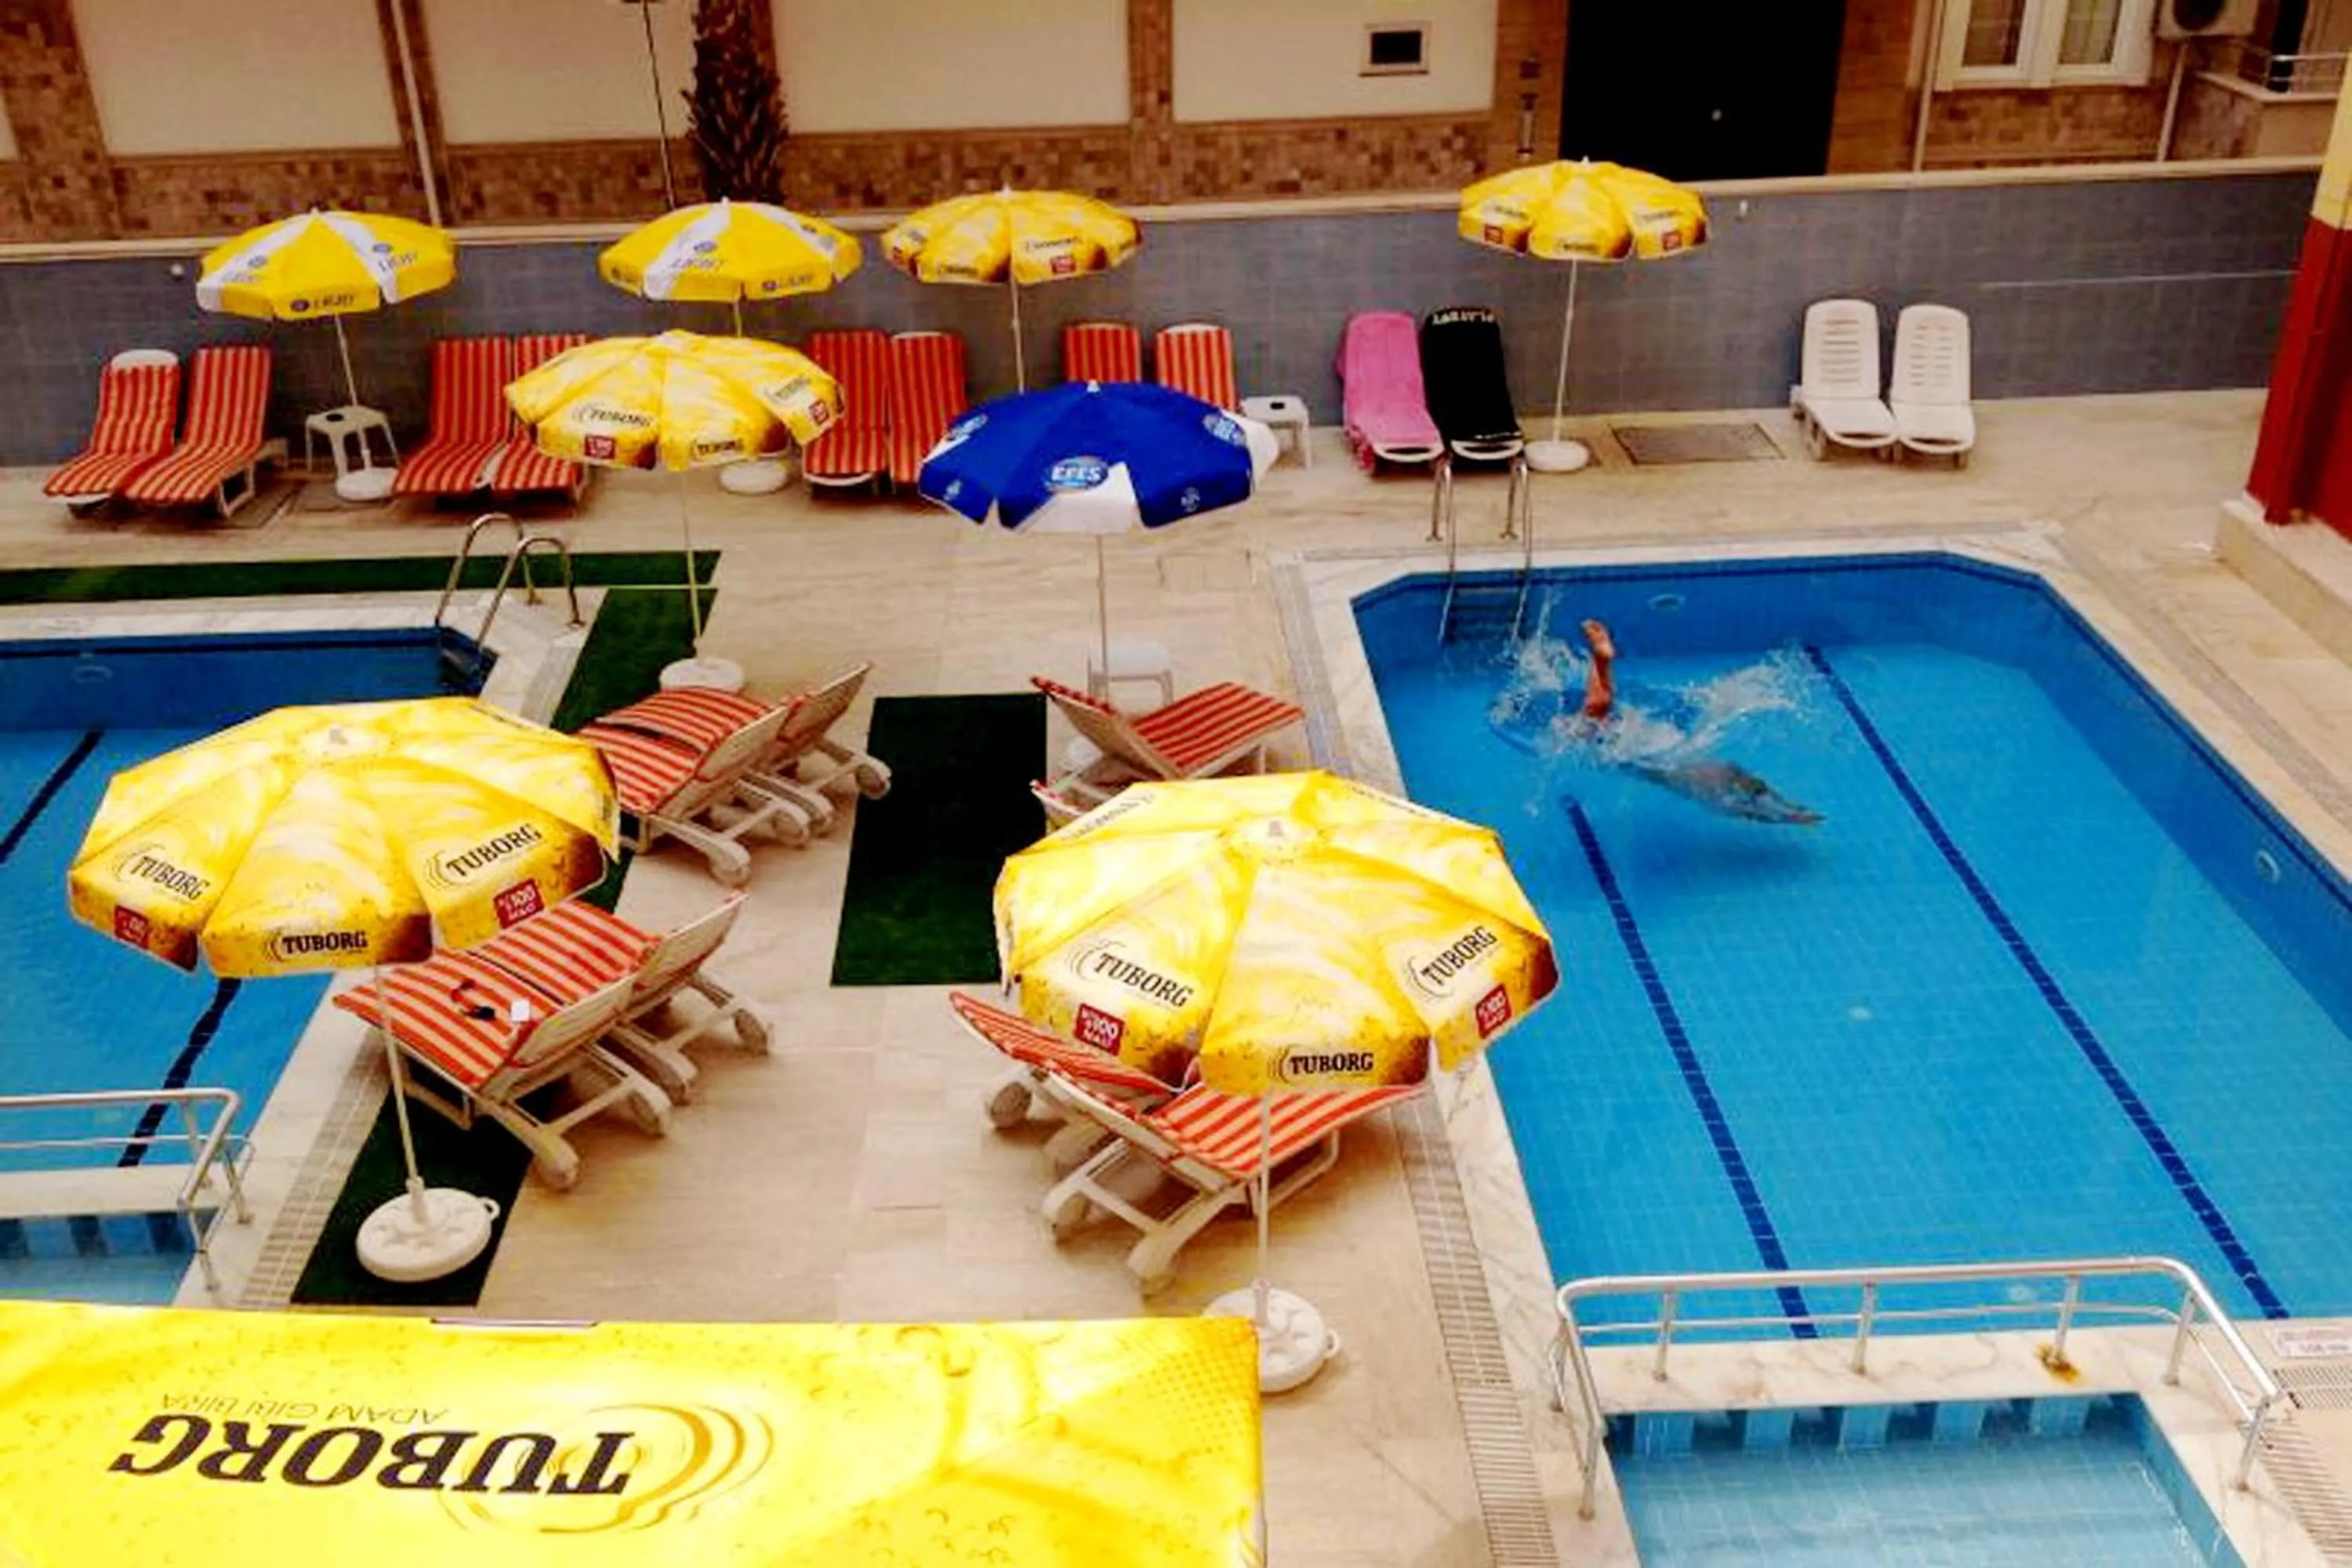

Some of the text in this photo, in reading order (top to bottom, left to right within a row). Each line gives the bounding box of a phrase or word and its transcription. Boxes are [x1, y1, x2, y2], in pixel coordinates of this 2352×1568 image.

[445, 822, 543, 877] TUBORG
[130, 855, 211, 901] TUBORG
[281, 929, 368, 954] TUBORG
[1420, 924, 1498, 986] TUBORG
[1094, 951, 1194, 1007] TUBORG
[1290, 1051, 1374, 1076] TUBORG
[108, 1414, 636, 1495] TUBORG
